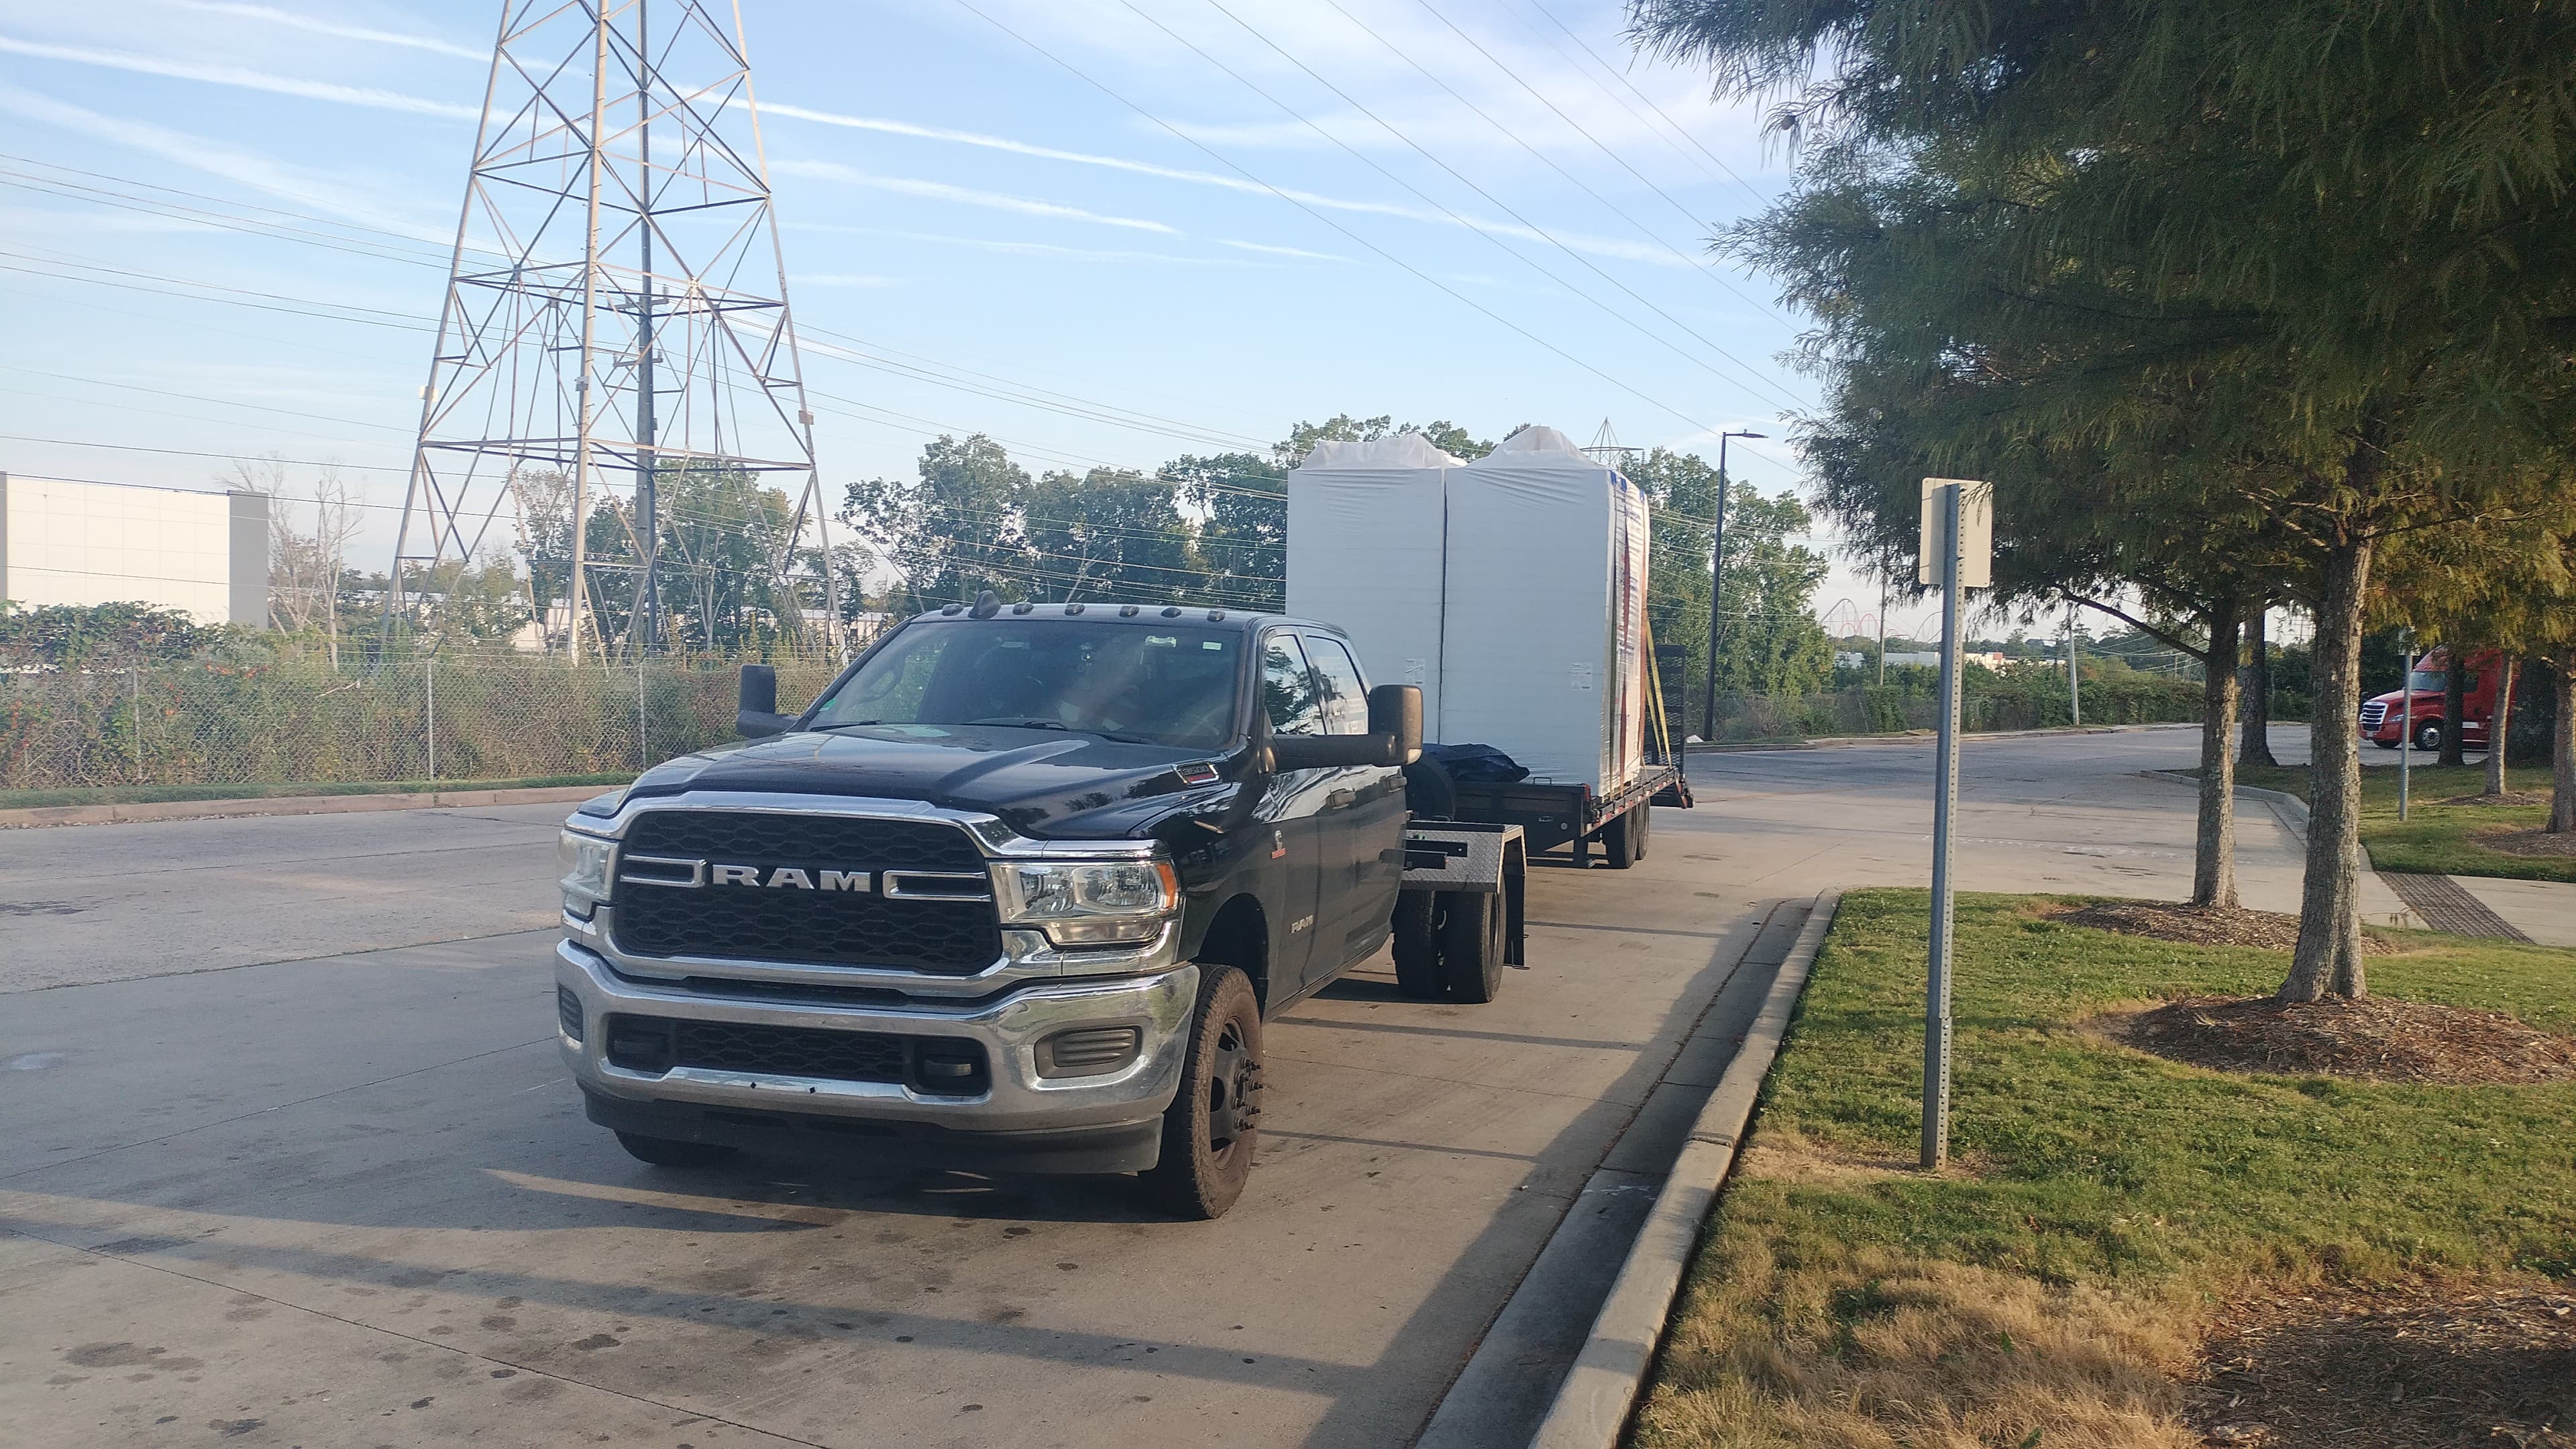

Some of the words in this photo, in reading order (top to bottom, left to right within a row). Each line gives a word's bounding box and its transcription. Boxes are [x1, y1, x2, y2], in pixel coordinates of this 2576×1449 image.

[1182, 765, 1209, 775] 3500
[712, 864, 871, 893] RAM
[1291, 914, 1313, 934] RAM
